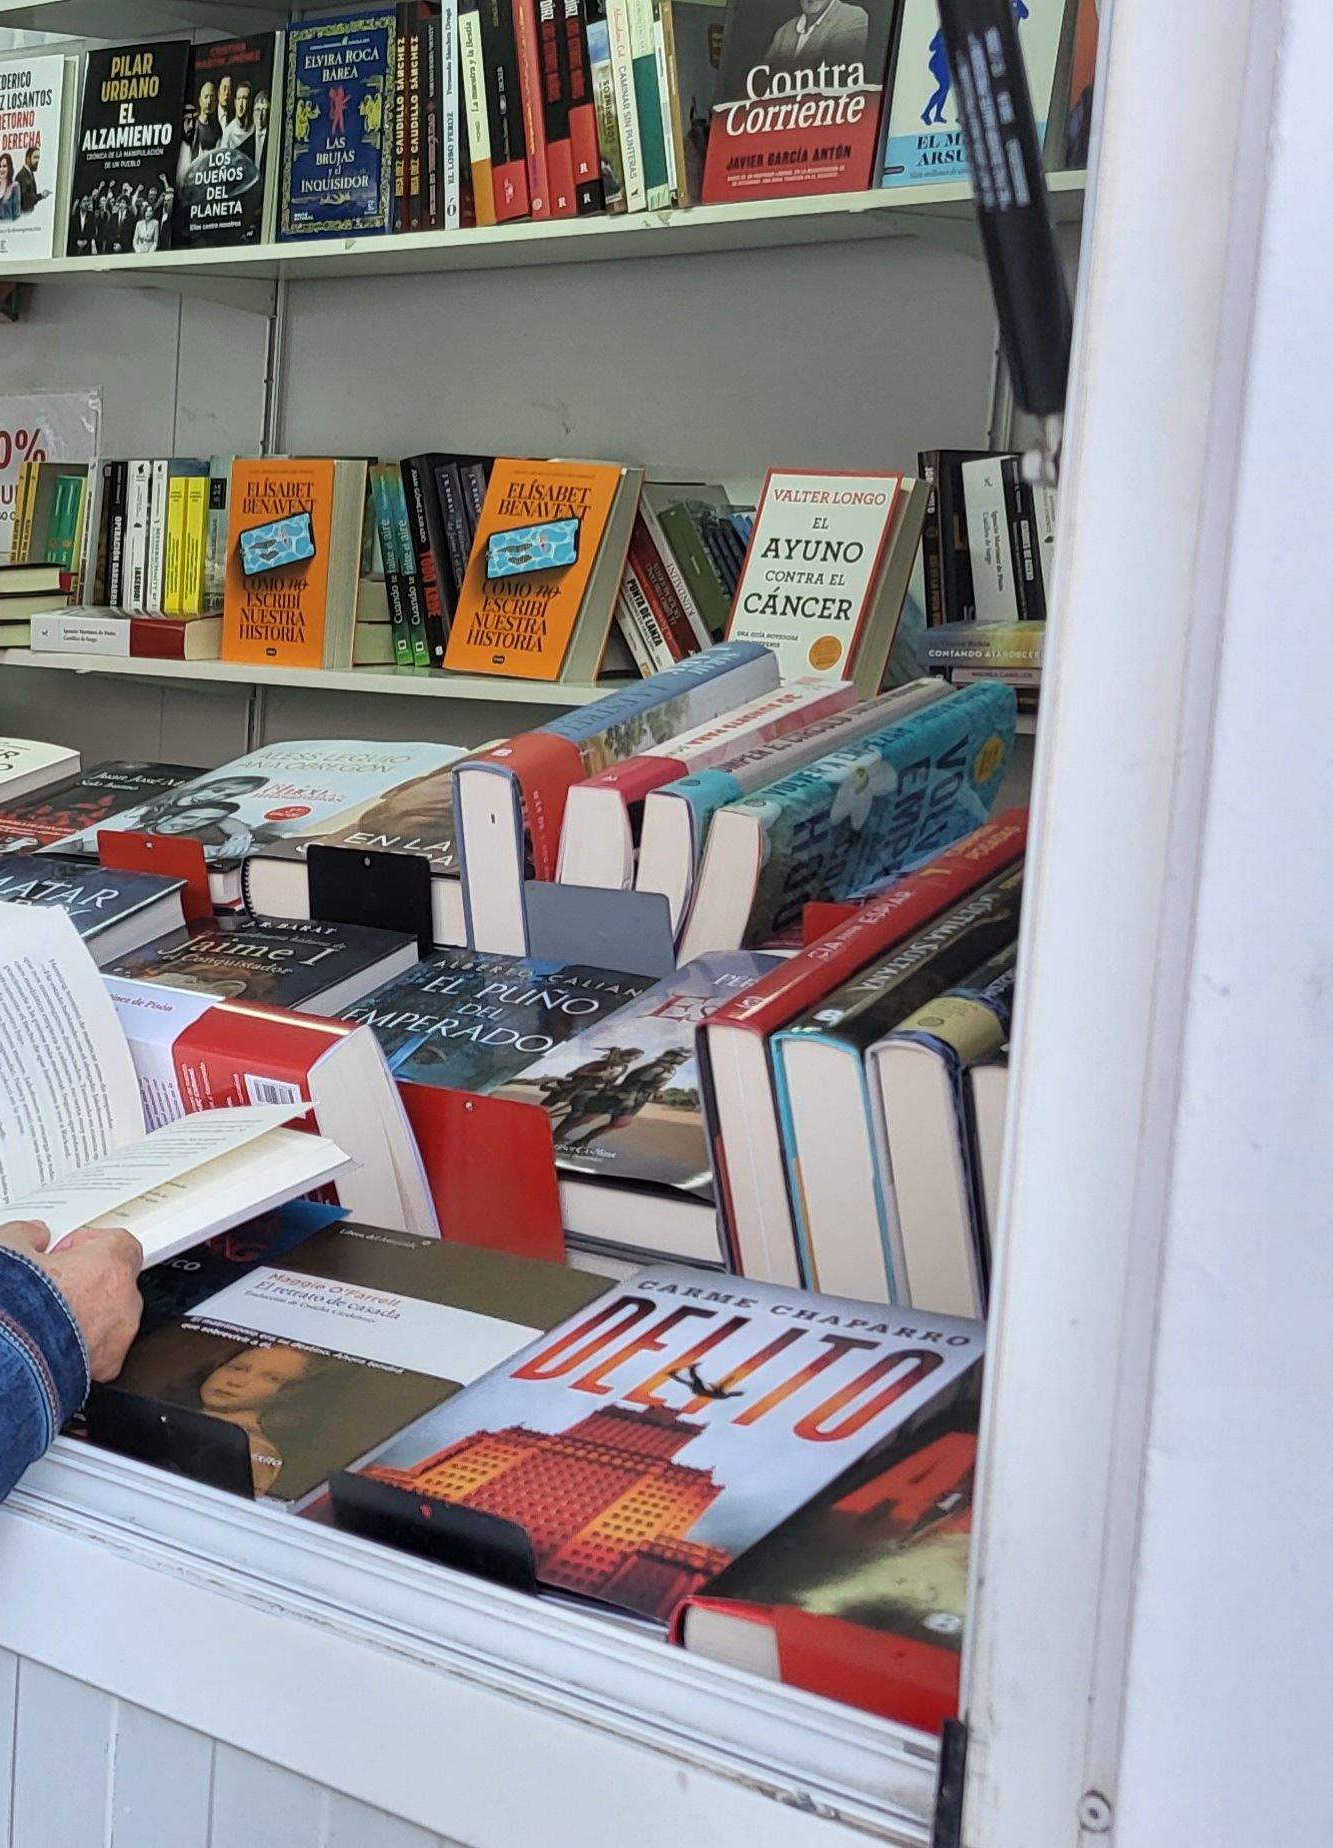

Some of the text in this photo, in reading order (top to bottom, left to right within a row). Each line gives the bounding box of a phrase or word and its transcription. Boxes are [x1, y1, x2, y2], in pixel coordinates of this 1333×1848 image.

[464, 20, 474, 48] Bestia
[110, 52, 153, 79] PILAR
[304, 46, 380, 70] ELVIRA ROCA
[322, 66, 359, 83] BAREA
[468, 67, 479, 100] maestra
[746, 61, 865, 101] Contra
[6, 89, 53, 110] LOSANTOS
[101, 76, 160, 102] URBANO
[119, 102, 136, 124] EL
[470, 101, 480, 113] La
[725, 92, 865, 137] Corriente
[2, 130, 41, 150] DERECHA
[82, 123, 173, 152] ALZAMIENTO
[326, 136, 347, 150] LAS
[917, 136, 941, 150] EL
[208, 151, 232, 168] LOS
[315, 150, 356, 166] BRUJAS
[726, 144, 852, 171] JAVIER GARCÍA ANTÓN
[194, 165, 244, 185] DUEÑOS
[301, 174, 369, 193] INQUISIDOR
[206, 186, 229, 201] DEL
[190, 200, 244, 219] PLANETA
[246, 478, 314, 499] ELÍSABET
[507, 478, 592, 502] ELÍSABET
[774, 488, 886, 506] VALTER LONGO
[242, 499, 317, 514] BENAVENT
[497, 500, 591, 520] BENAVENT
[812, 517, 829, 530] EL
[760, 537, 864, 564] AYUNO
[419, 550, 442, 618] TODO ARDE
[765, 570, 846, 586] CONTRA EL
[246, 593, 301, 609] ESCRIBÍ
[482, 596, 550, 615] ESCRIBÍ
[743, 586, 853, 621] CÁNCER
[240, 610, 306, 627] NUESTRA
[472, 612, 548, 635] NUESTRA
[626, 578, 664, 648] PUNTA DE LANZA
[239, 626, 306, 643] HISTORIA
[466, 630, 544, 652] HISTORIA
[928, 649, 1041, 659] CONTANDO ATARDECER
[343, 831, 452, 852] EN LA
[158, 934, 343, 967] Jaime I
[421, 976, 600, 1016] EL PUÑO
[547, 974, 646, 997] CALIAN
[131, 998, 173, 1013] de Pisón
[455, 1003, 504, 1020] DEL
[341, 1007, 555, 1053] EMPERADO
[267, 1271, 402, 1307] Maggie O'Farrell
[253, 1280, 401, 1320] El retrato de casada
[637, 1278, 971, 1347] CARME CHAPARRO
[509, 1294, 946, 1443] DELITO
